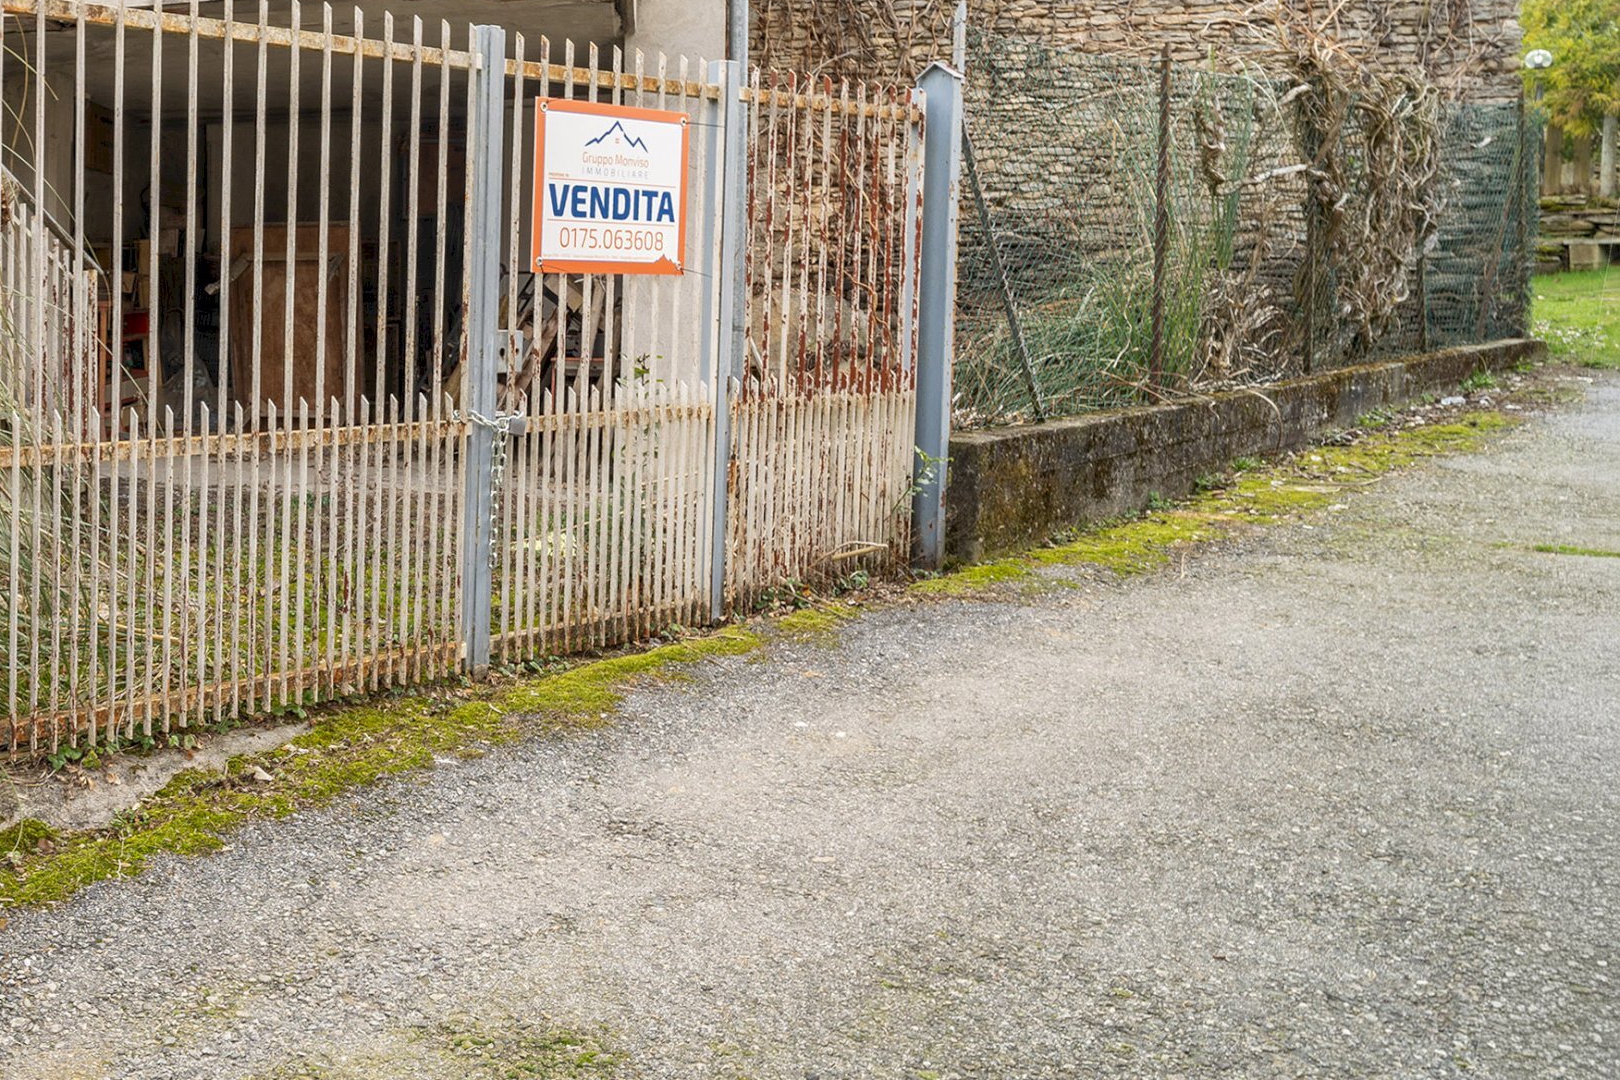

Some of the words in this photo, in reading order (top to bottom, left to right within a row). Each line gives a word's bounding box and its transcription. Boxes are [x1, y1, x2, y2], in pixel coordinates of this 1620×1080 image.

[582, 151, 613, 166] Gruppo
[615, 154, 650, 168] Monviso
[581, 166, 649, 180] IMMOBILIARE
[549, 183, 675, 223] VENDITA
[559, 227, 664, 251] 0175.063608
